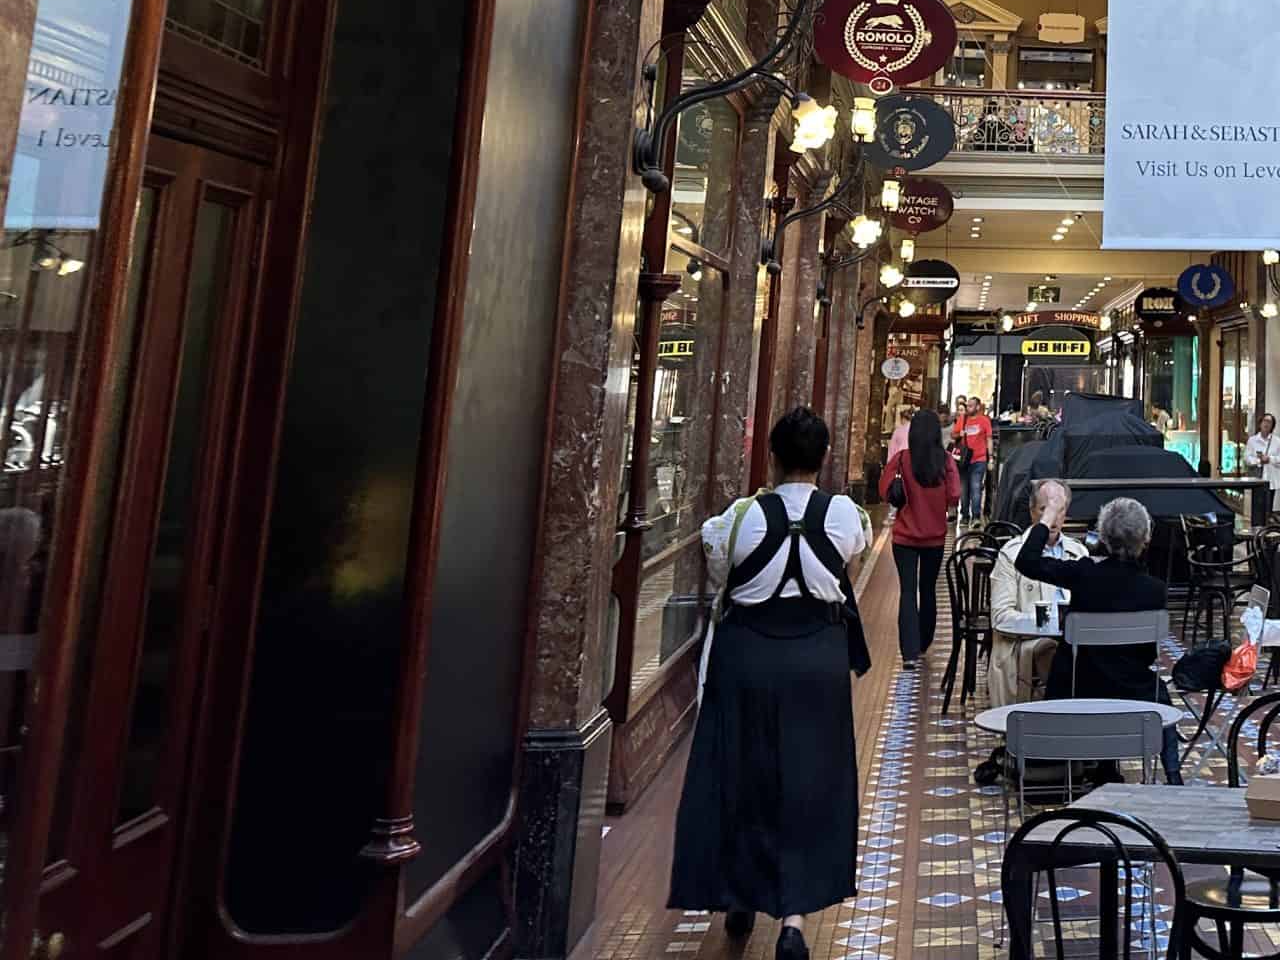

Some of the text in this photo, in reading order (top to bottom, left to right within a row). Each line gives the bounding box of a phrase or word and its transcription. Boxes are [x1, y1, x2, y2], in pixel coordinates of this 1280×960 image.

[855, 31, 914, 44] ROMOLO
[1135, 160, 1177, 177] Visit
[1185, 160, 1209, 178] Us
[1214, 163, 1236, 179] on
[902, 196, 939, 206] NTAGE
[898, 206, 936, 216] WATCH
[1017, 312, 1099, 325] LIFT SHOPPING
[1027, 342, 1048, 353] JB
